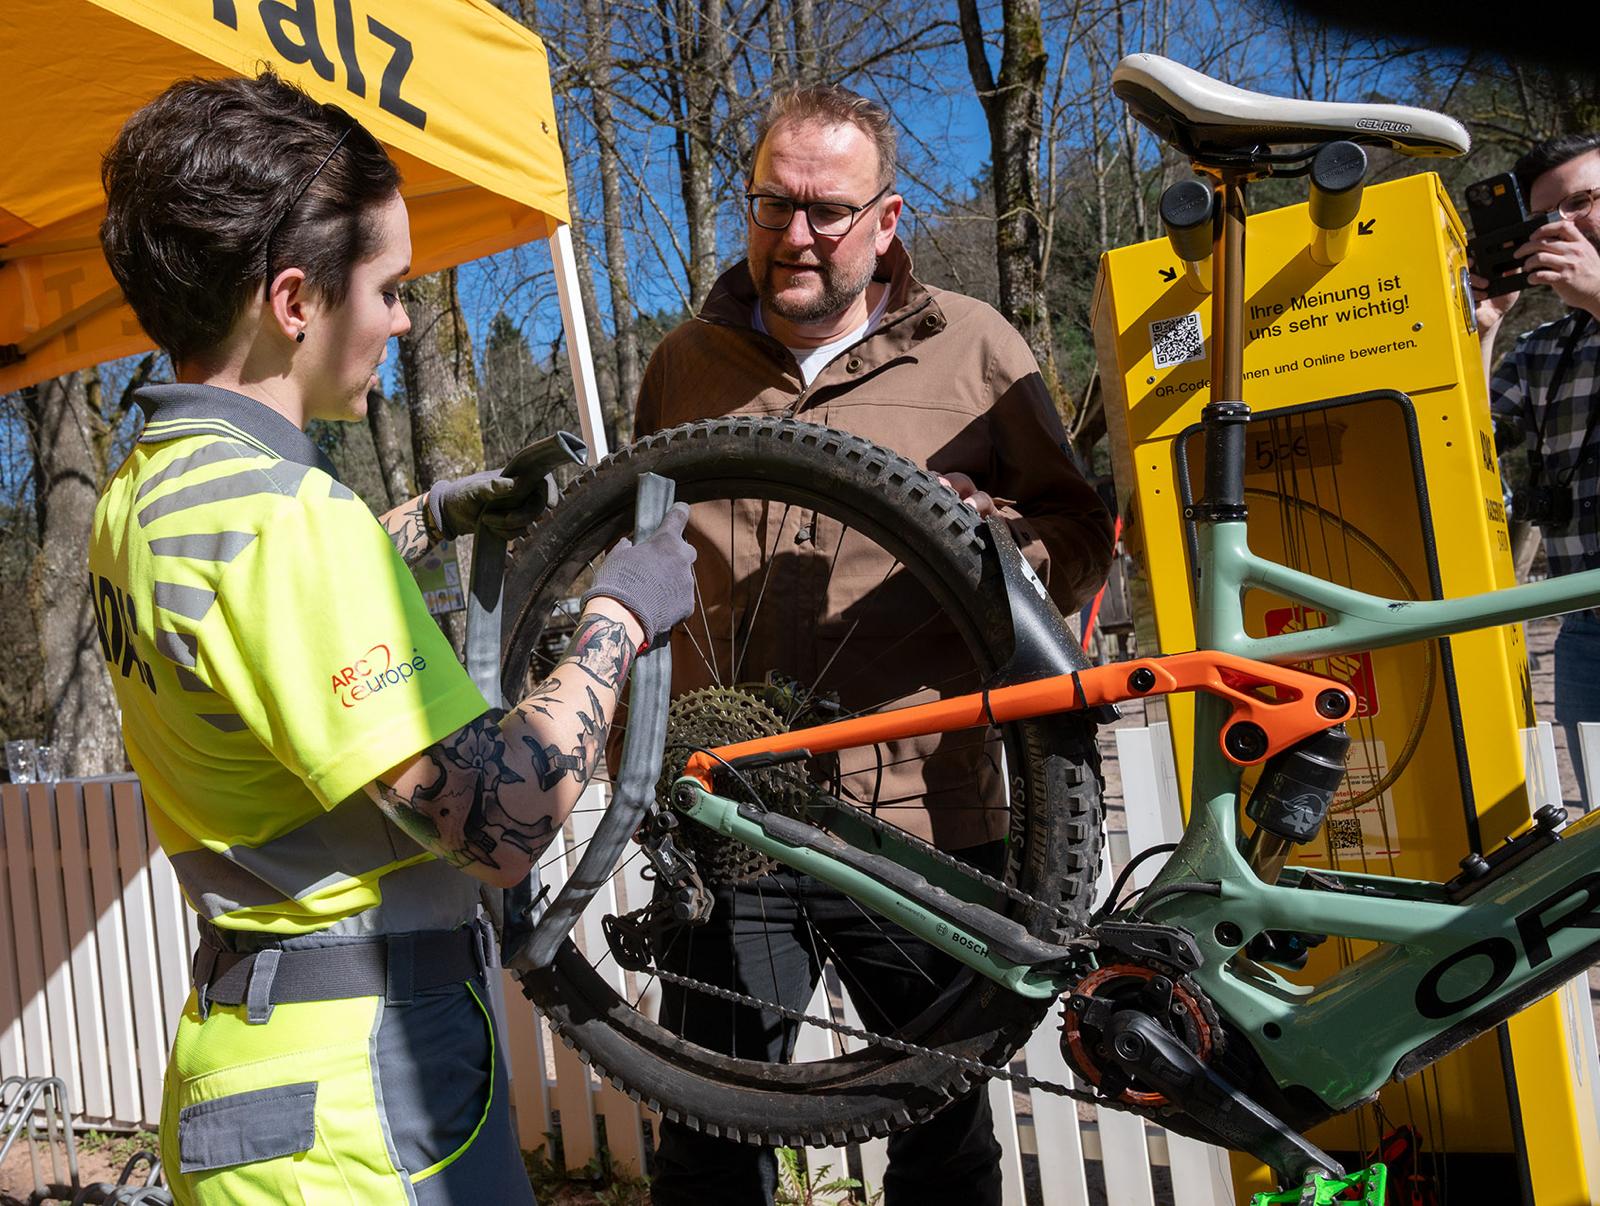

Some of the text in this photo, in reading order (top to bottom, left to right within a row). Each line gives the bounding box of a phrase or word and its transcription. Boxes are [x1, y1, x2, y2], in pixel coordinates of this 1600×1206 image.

[1379, 120, 1412, 134] PLUS
[1250, 275, 1402, 320] Ihre Meinung ist
[1249, 294, 1410, 341] uns sehr wichtig!
[1274, 360, 1299, 374] und
[1303, 351, 1346, 368] Online
[1350, 337, 1418, 360] bewerten.
[331, 659, 372, 694] ARC
[1010, 774, 1026, 849] SWISS
[951, 932, 989, 958] BOSCH
